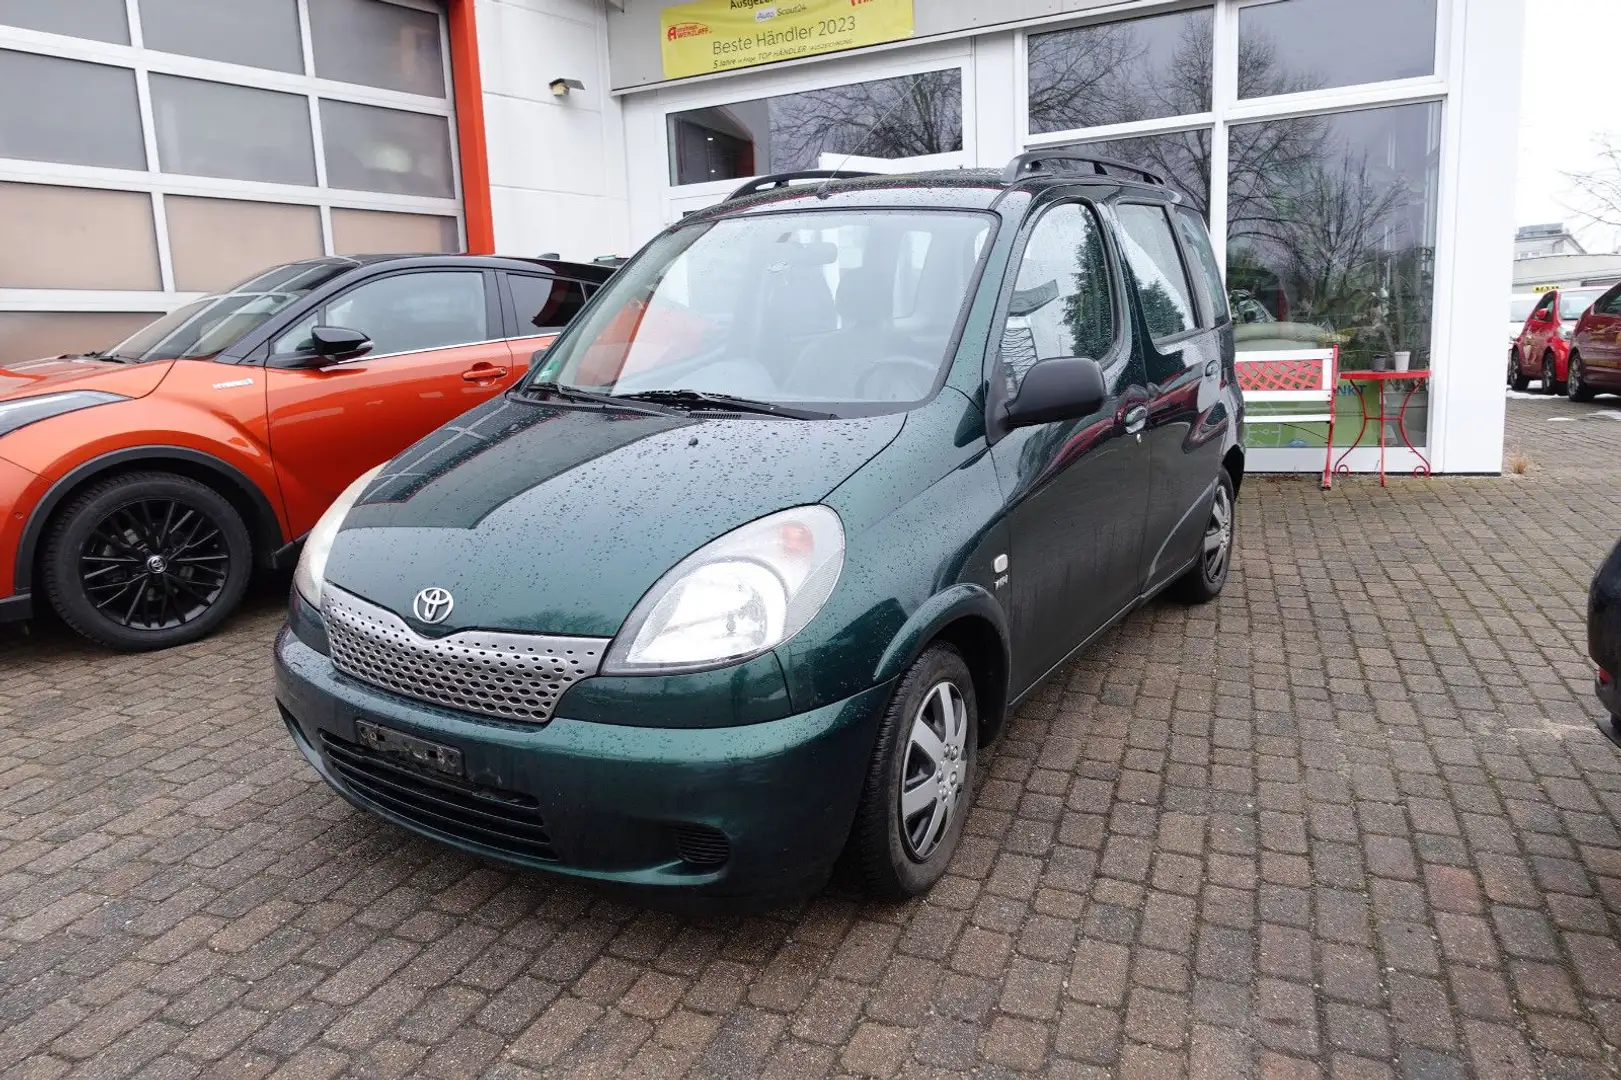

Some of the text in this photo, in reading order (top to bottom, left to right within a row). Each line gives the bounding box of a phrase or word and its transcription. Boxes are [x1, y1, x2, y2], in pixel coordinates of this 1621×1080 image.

[776, 4, 807, 16] Scout24
[713, 15, 856, 55] Beste Händler 2023
[713, 59, 718, 69] 5
[758, 51, 772, 60] TOP
